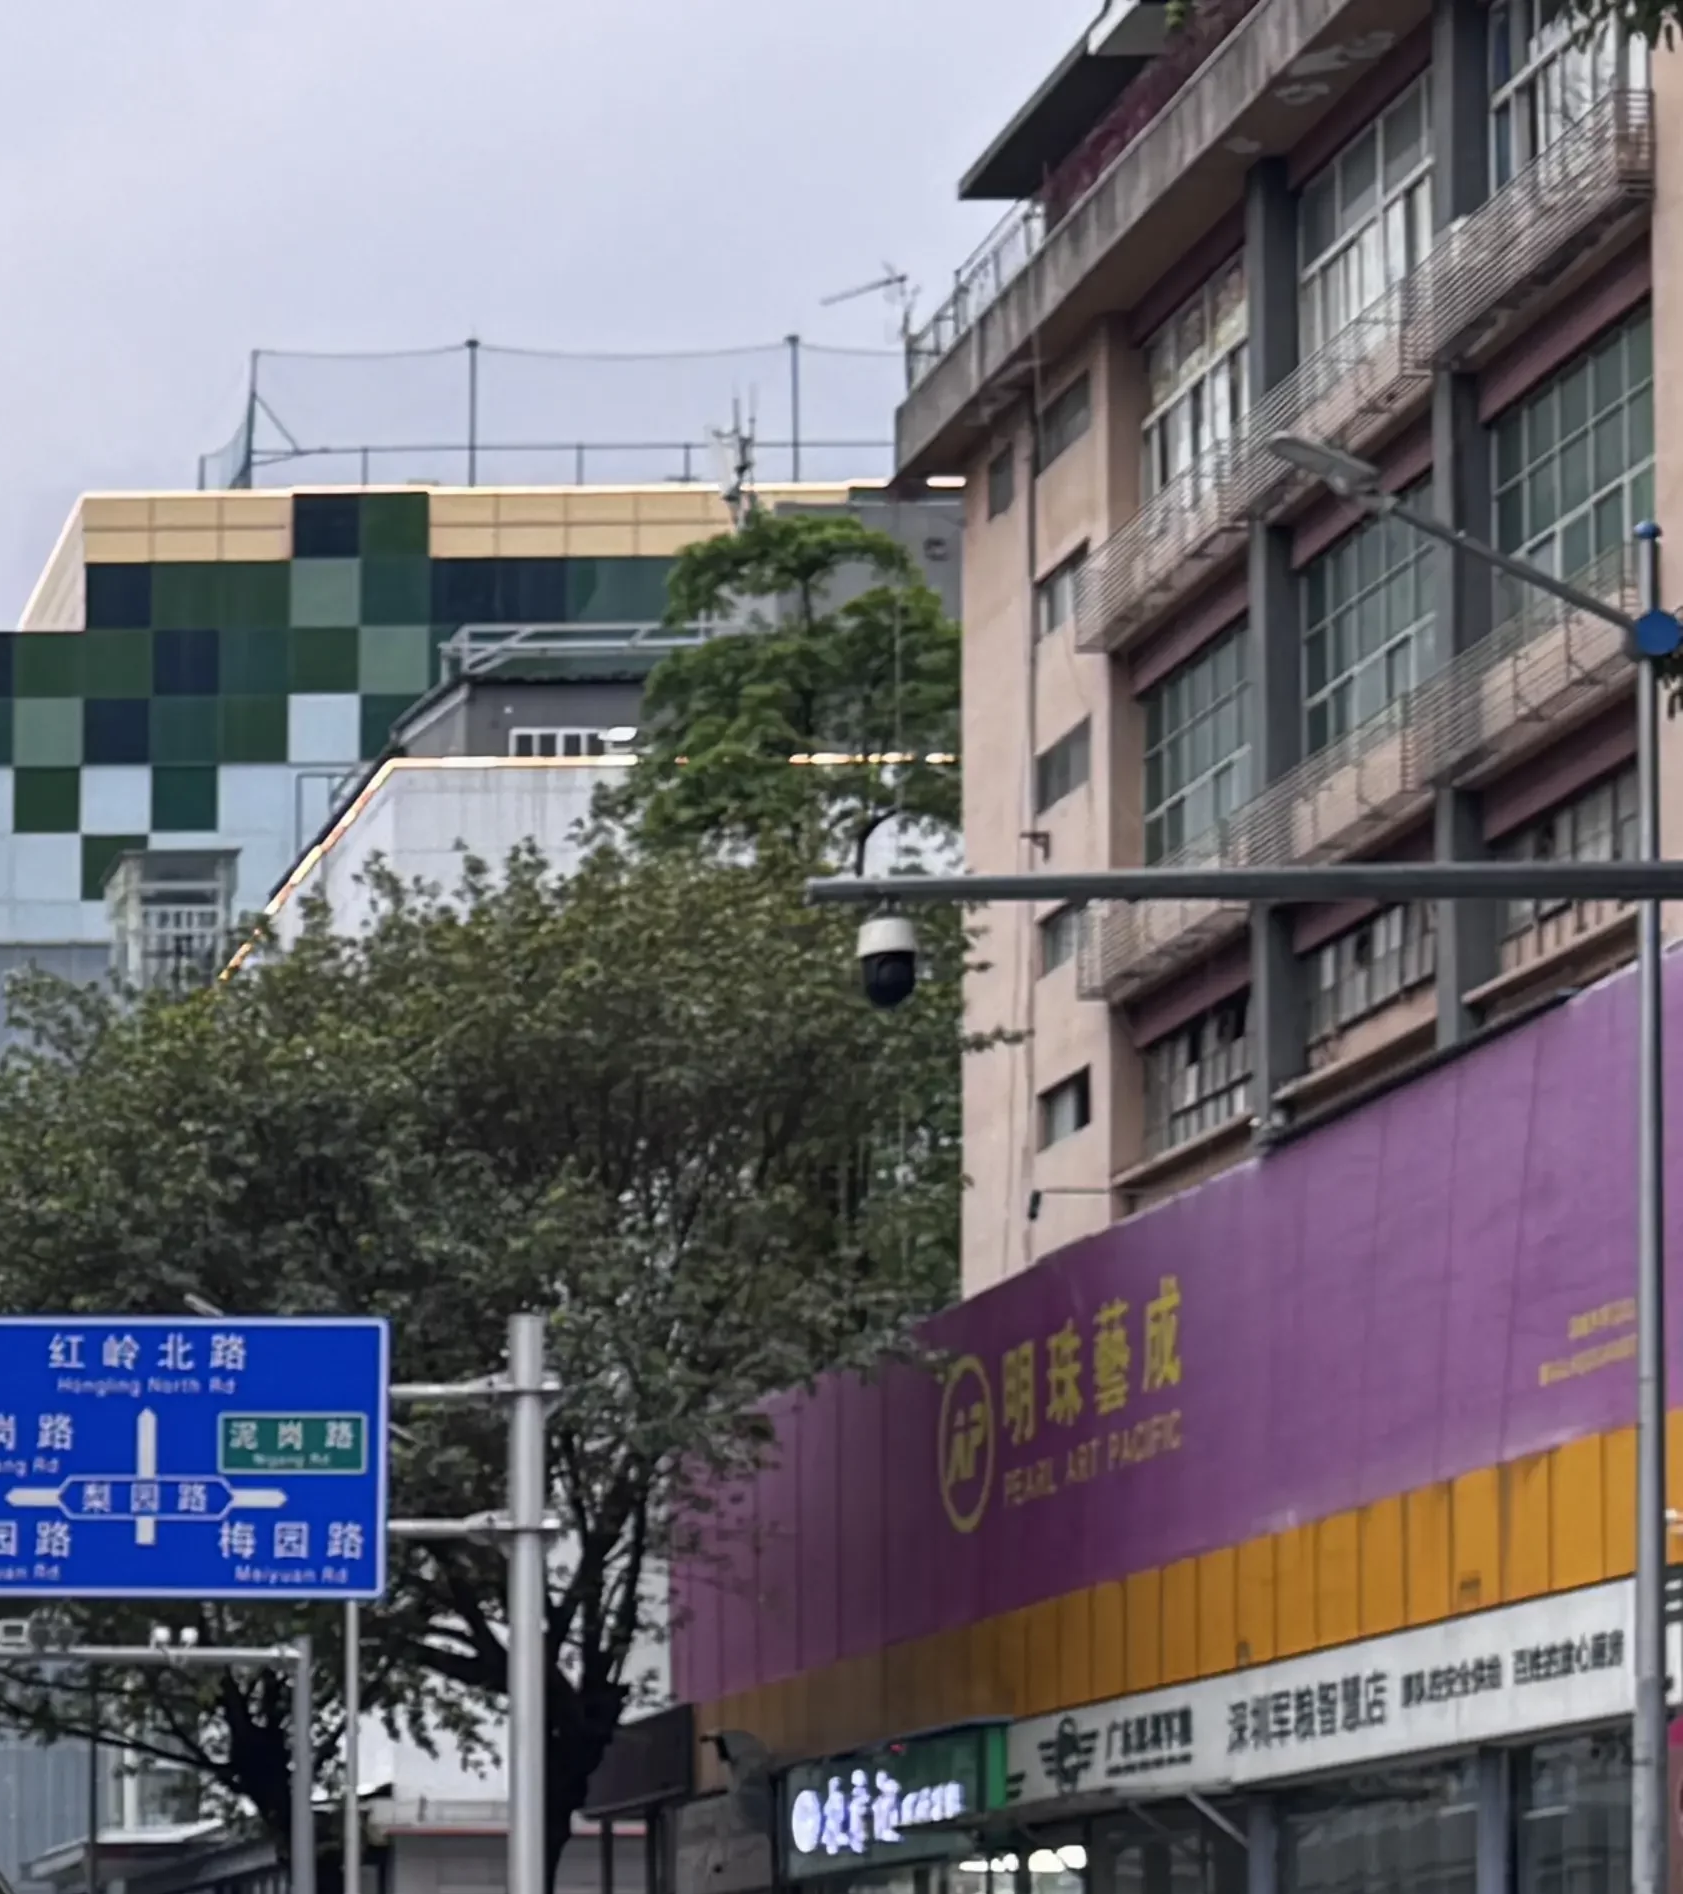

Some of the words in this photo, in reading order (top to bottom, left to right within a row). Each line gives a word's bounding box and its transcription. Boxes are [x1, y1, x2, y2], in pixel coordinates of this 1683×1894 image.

[48, 1333, 246, 1371] 红岭北路
[57, 1376, 142, 1397] Hongling
[148, 1376, 201, 1394] North
[210, 1376, 236, 1394] Rd
[229, 1420, 354, 1451] 泥岗路
[33, 1455, 59, 1473] Rd
[1066, 1437, 1101, 1485] ART
[218, 1520, 365, 1560] 梅园路
[34, 1563, 60, 1580] Rd
[235, 1565, 317, 1585] Meiyuan
[321, 1566, 349, 1583] Rd
